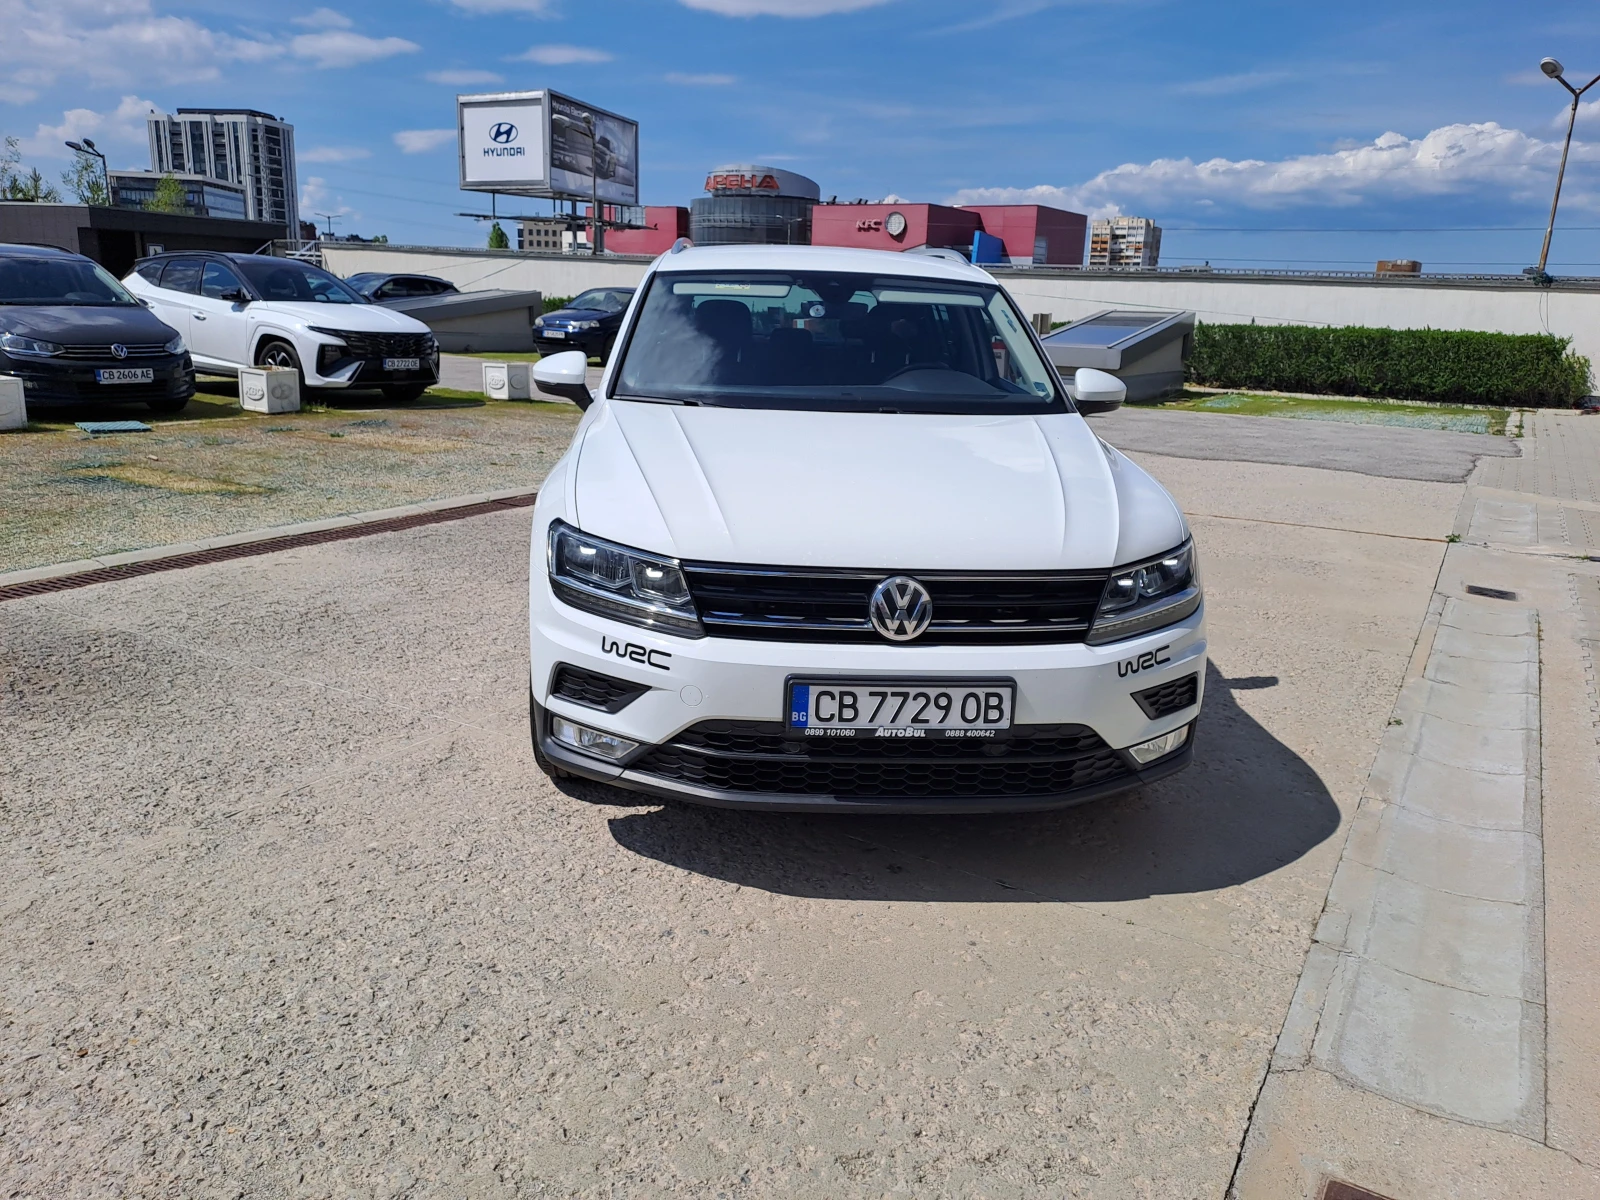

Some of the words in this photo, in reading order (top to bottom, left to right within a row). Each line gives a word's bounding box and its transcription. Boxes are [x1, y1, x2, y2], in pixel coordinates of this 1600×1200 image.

[483, 147, 525, 157] HYUNDAI
[704, 174, 780, 190] АРЕНА
[855, 219, 881, 228] KFC
[102, 370, 115, 380] CB
[117, 370, 139, 380] 2606
[141, 369, 153, 379] AE
[602, 635, 672, 670] WRC
[1117, 644, 1171, 677] WRC
[791, 711, 807, 722] BG
[815, 690, 859, 723] CB
[868, 691, 953, 724] 7729
[804, 728, 825, 736] 0899
[826, 729, 856, 737] 101060
[966, 730, 996, 738] 400642
